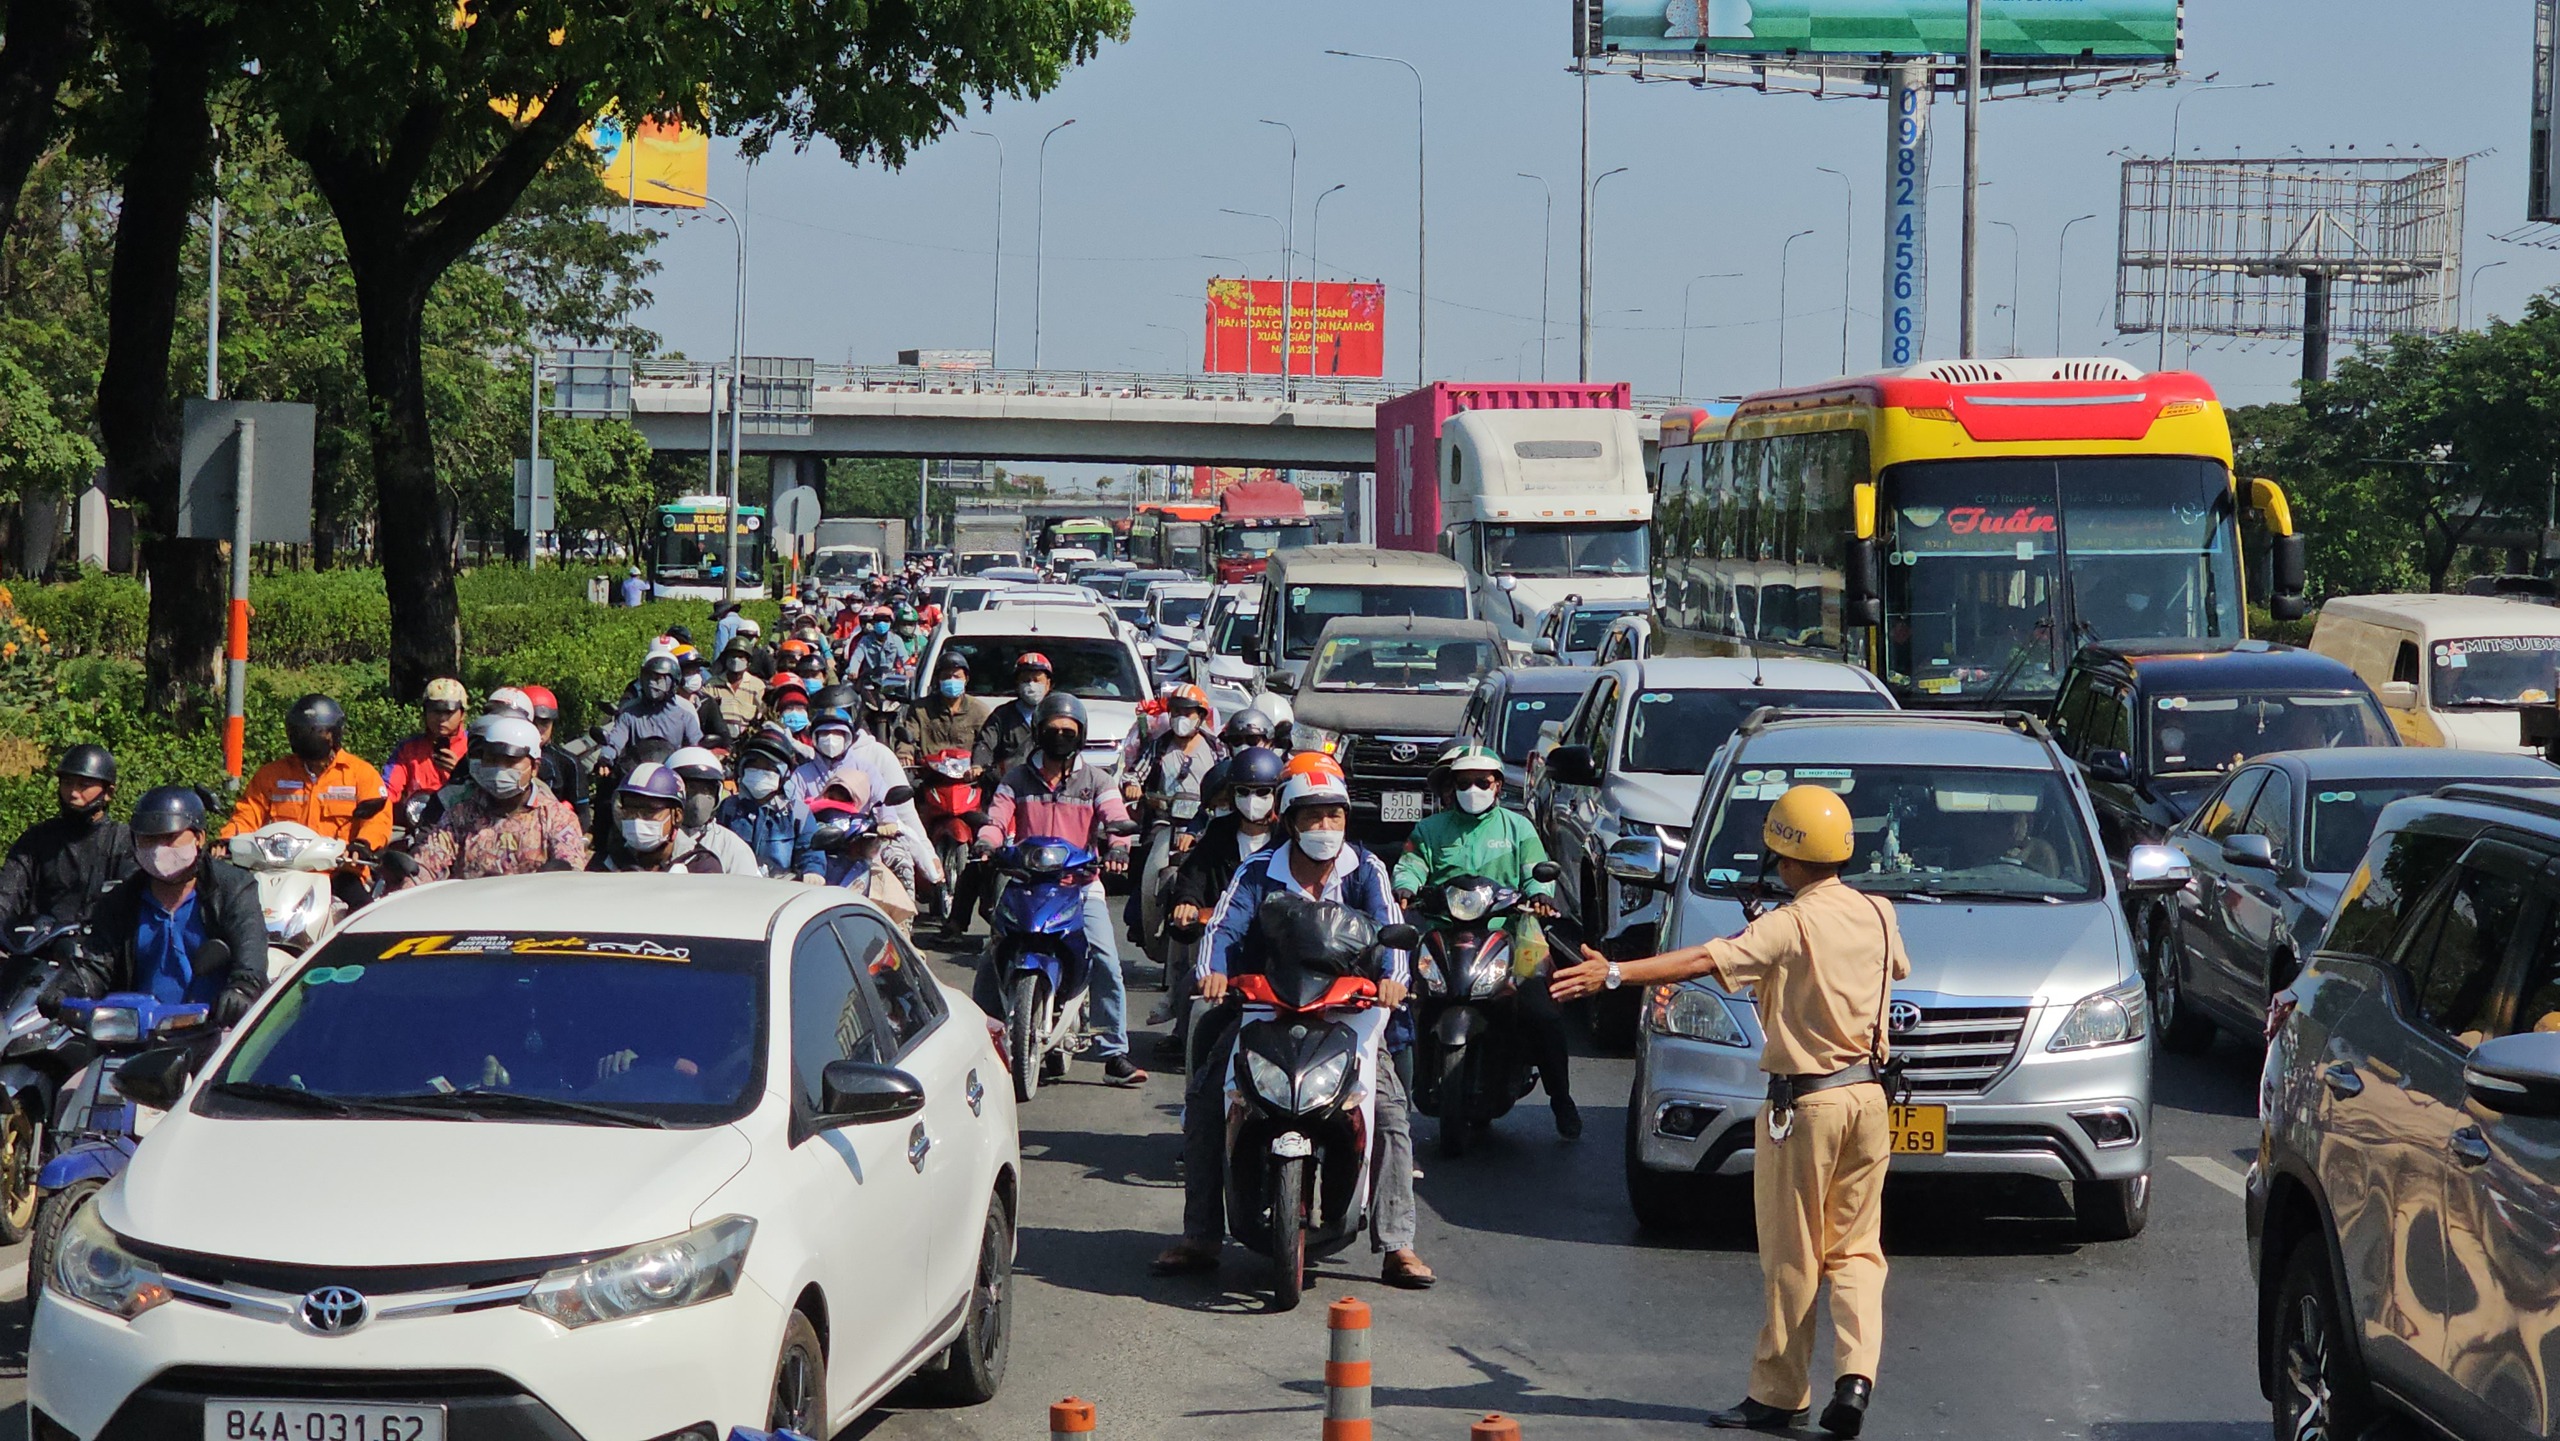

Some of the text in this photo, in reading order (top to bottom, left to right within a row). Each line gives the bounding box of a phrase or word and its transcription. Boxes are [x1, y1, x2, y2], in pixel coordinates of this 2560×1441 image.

[1271, 345, 1295, 354] NM
[1947, 506, 2058, 535] Tuấn
[1392, 793, 1413, 807] 51D
[1769, 819, 1807, 845] CSGT
[226, 1409, 424, 1441] 84A-031.62
